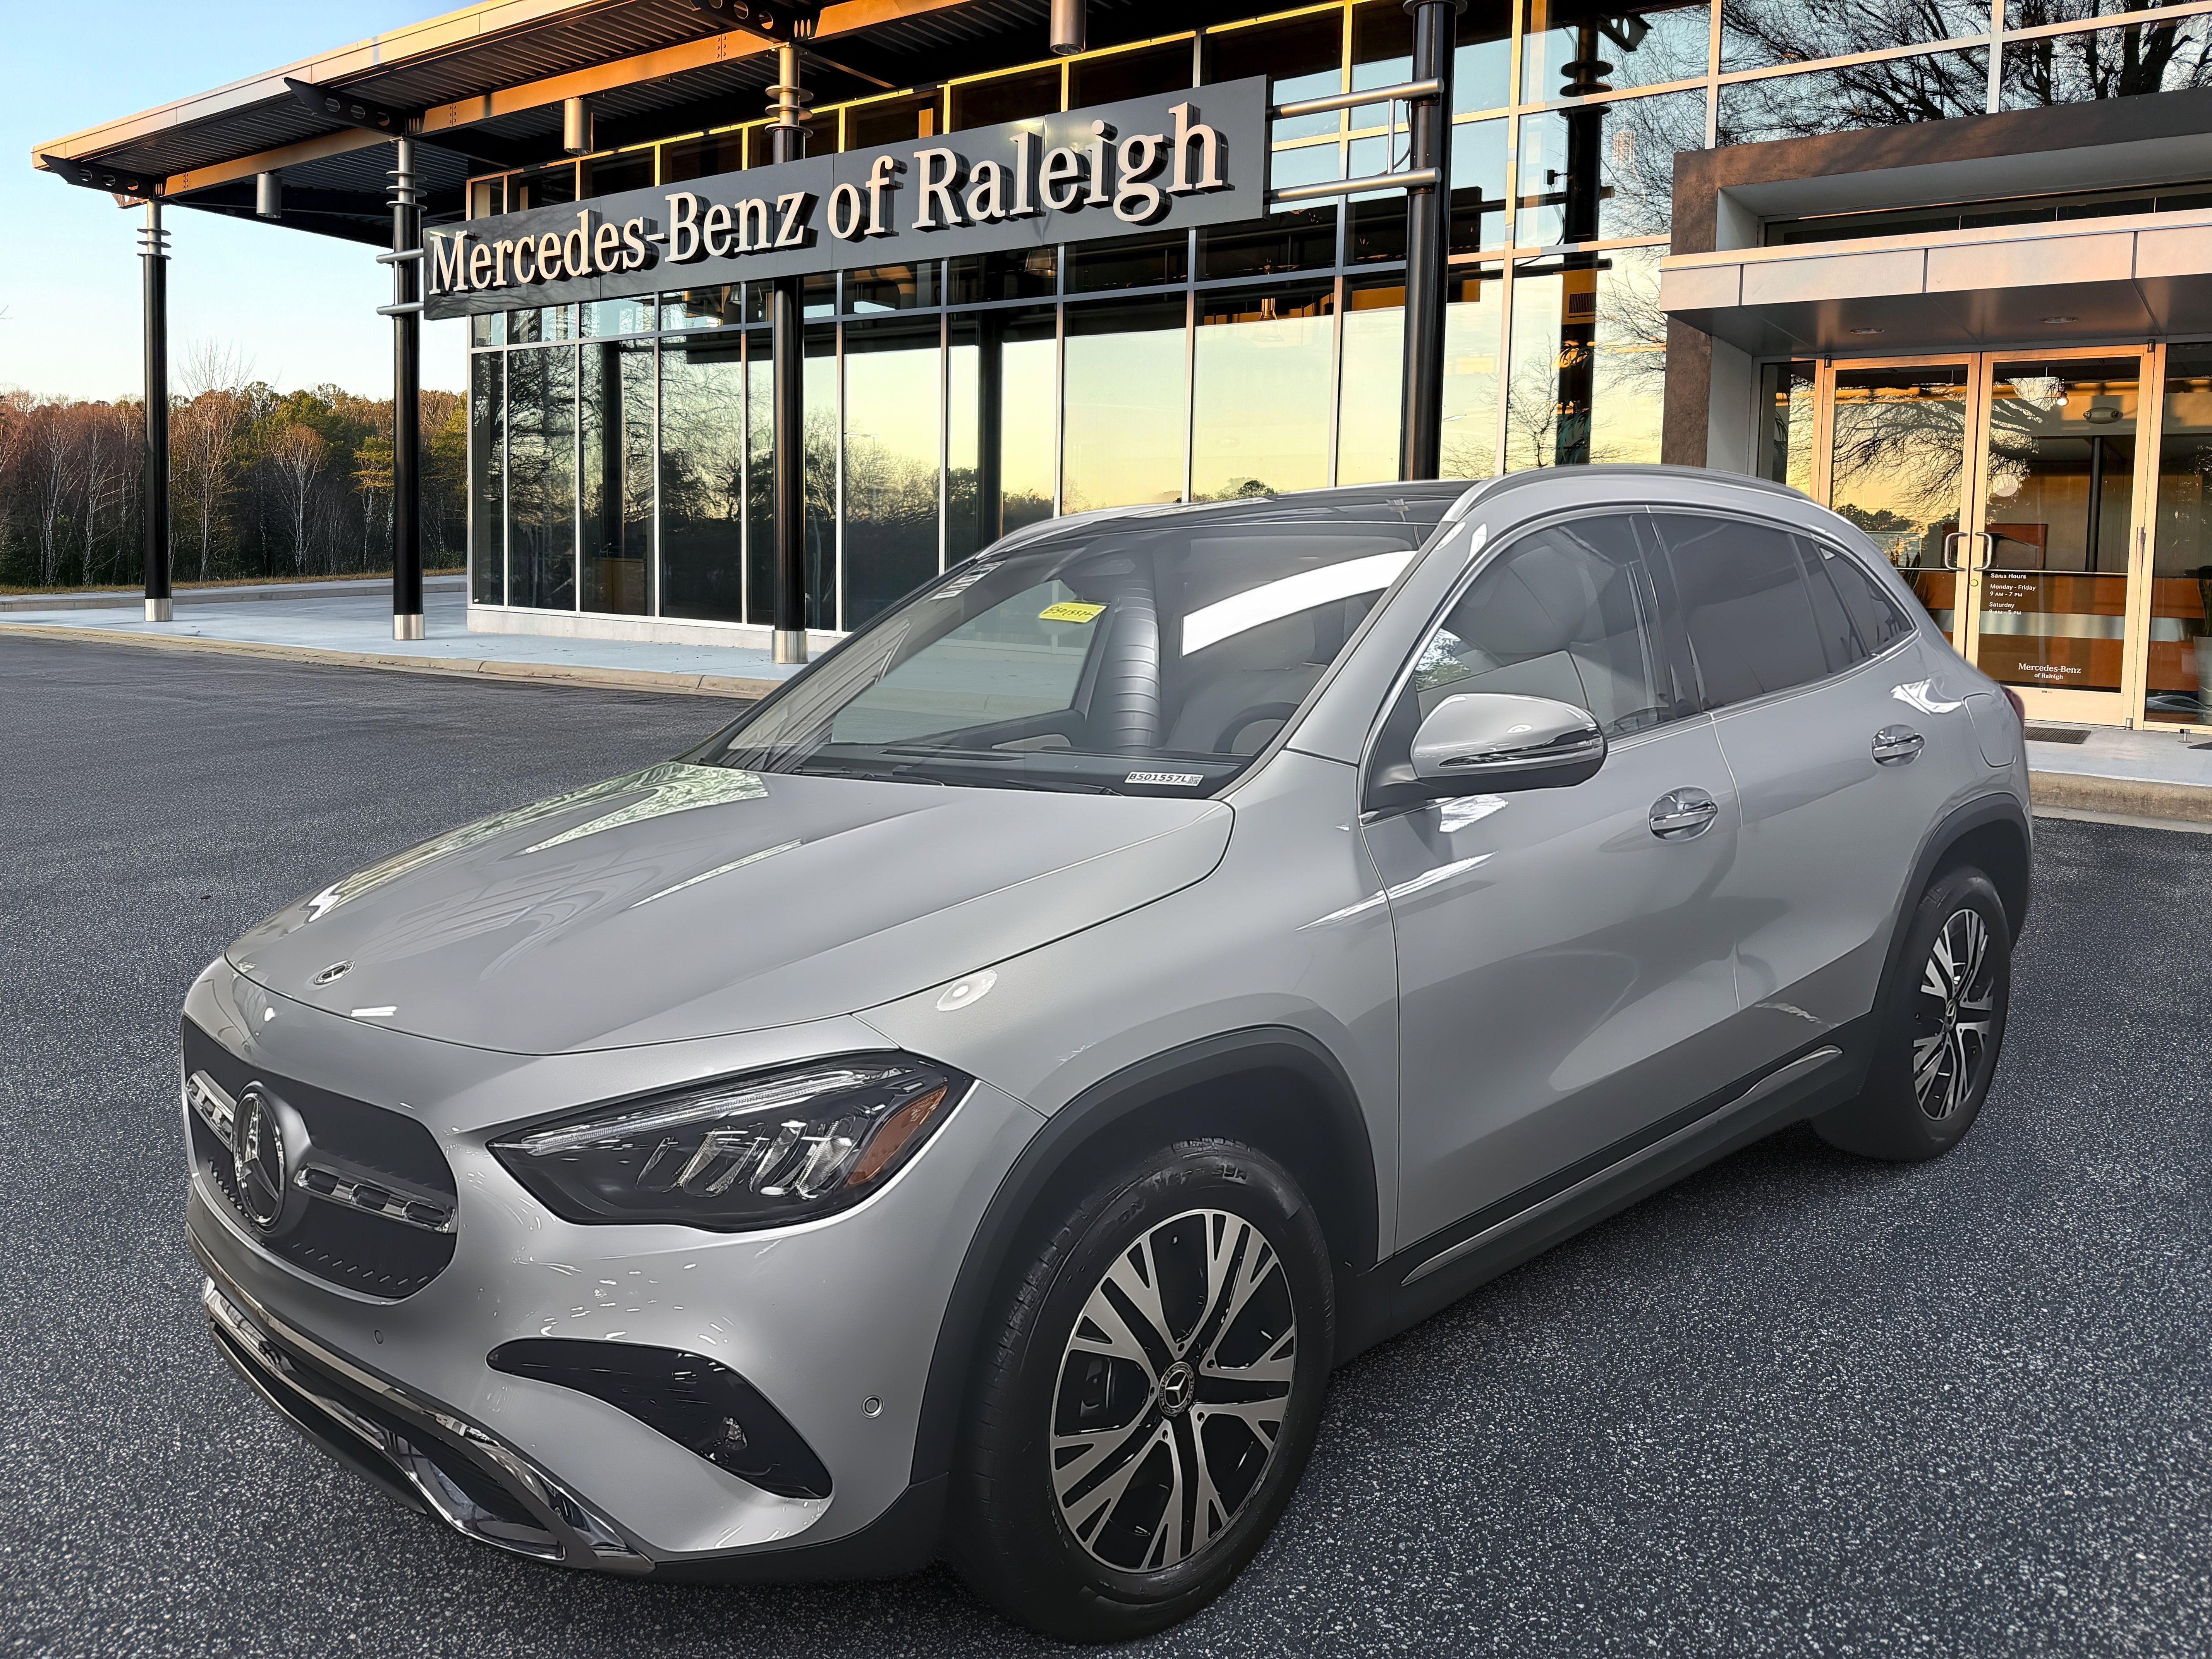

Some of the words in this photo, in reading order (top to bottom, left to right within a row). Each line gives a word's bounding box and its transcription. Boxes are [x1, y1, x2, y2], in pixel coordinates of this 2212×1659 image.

[429, 192, 807, 295] Mercedes-Benz
[828, 155, 898, 239] of
[912, 101, 1224, 222] Raleigh
[2018, 663, 2081, 674] Mercedes-Benz
[1128, 773, 1188, 782] B501557L
